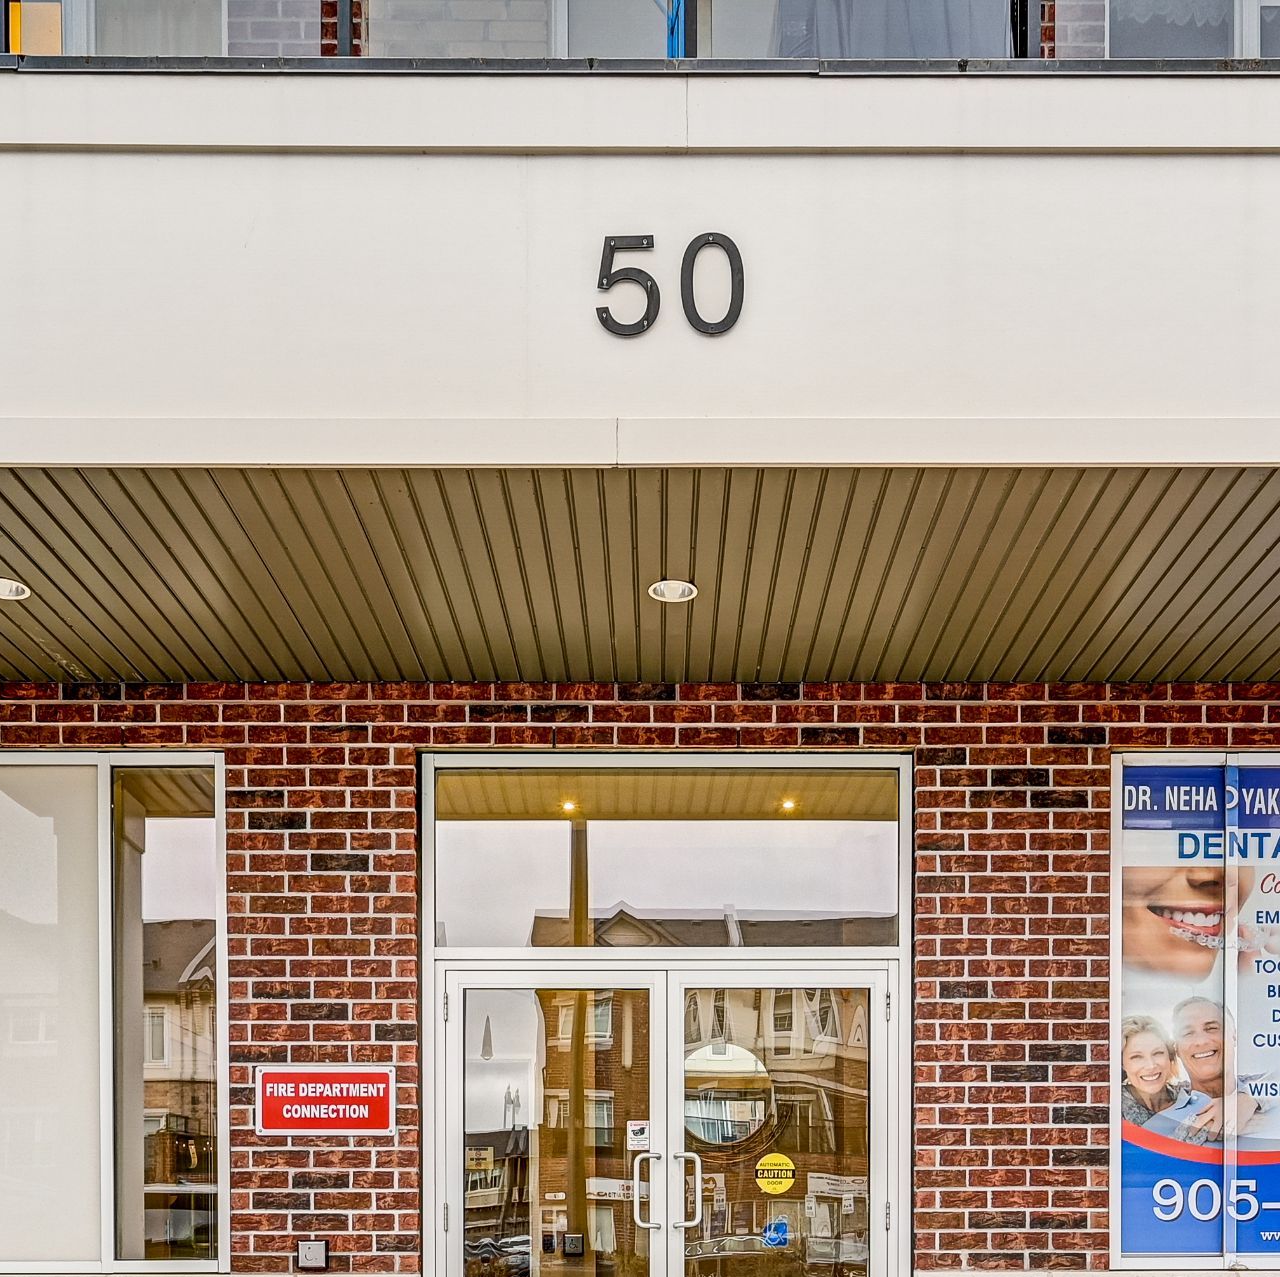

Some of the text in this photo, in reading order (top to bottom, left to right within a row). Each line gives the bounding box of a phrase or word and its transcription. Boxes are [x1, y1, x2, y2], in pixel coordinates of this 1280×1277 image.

[595, 231, 745, 337] 50
[1124, 785, 1158, 811] DR.
[1166, 786, 1218, 811] NEHA
[265, 1083, 387, 1097] FIRE DEPARTMENT
[282, 1104, 369, 1118] CONNECTION
[757, 1169, 793, 1178] CAUTION
